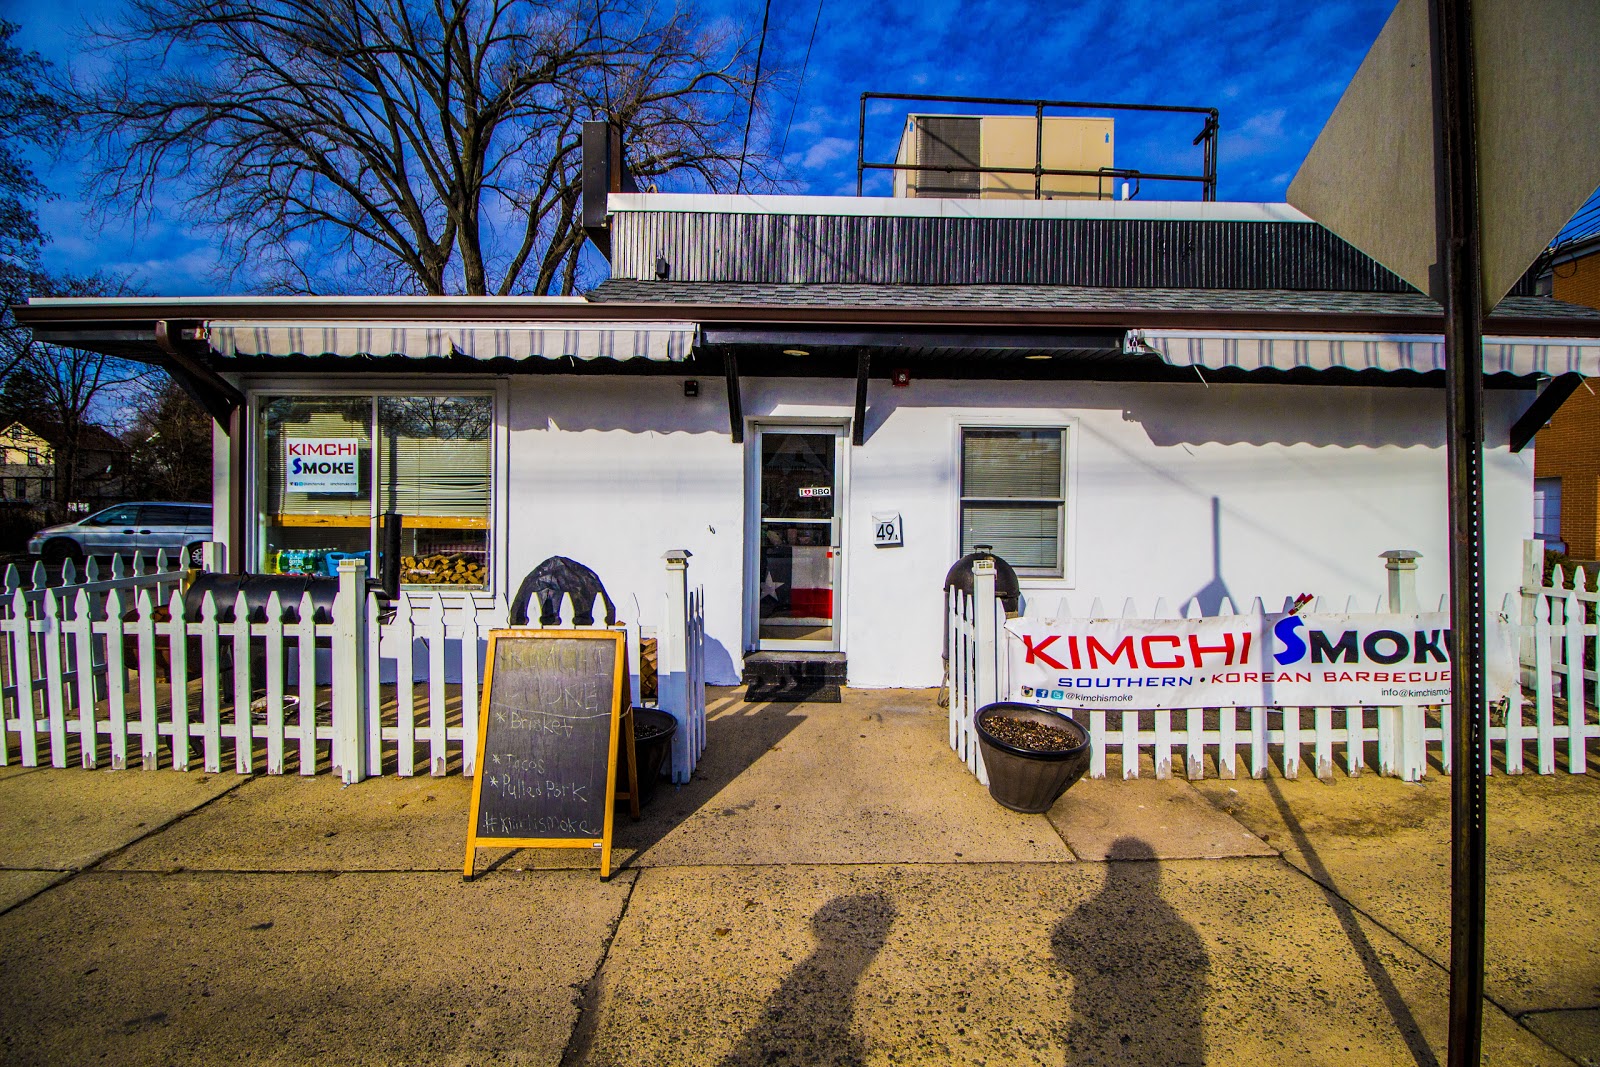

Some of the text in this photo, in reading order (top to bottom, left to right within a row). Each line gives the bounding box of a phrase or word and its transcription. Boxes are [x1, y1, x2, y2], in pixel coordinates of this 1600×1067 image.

[289, 443, 357, 456] KIMCHI
[292, 457, 354, 475] SMOKE
[812, 488, 830, 496] BBQ
[1022, 632, 1252, 670] KIMCHI
[1057, 670, 1451, 688] SOUTHERN KOREAN BARBECUE
[1065, 692, 1133, 702] @kimchismoke
[511, 711, 574, 738] Brisket
[504, 753, 545, 775] Tacos
[502, 773, 542, 799] Pulled
